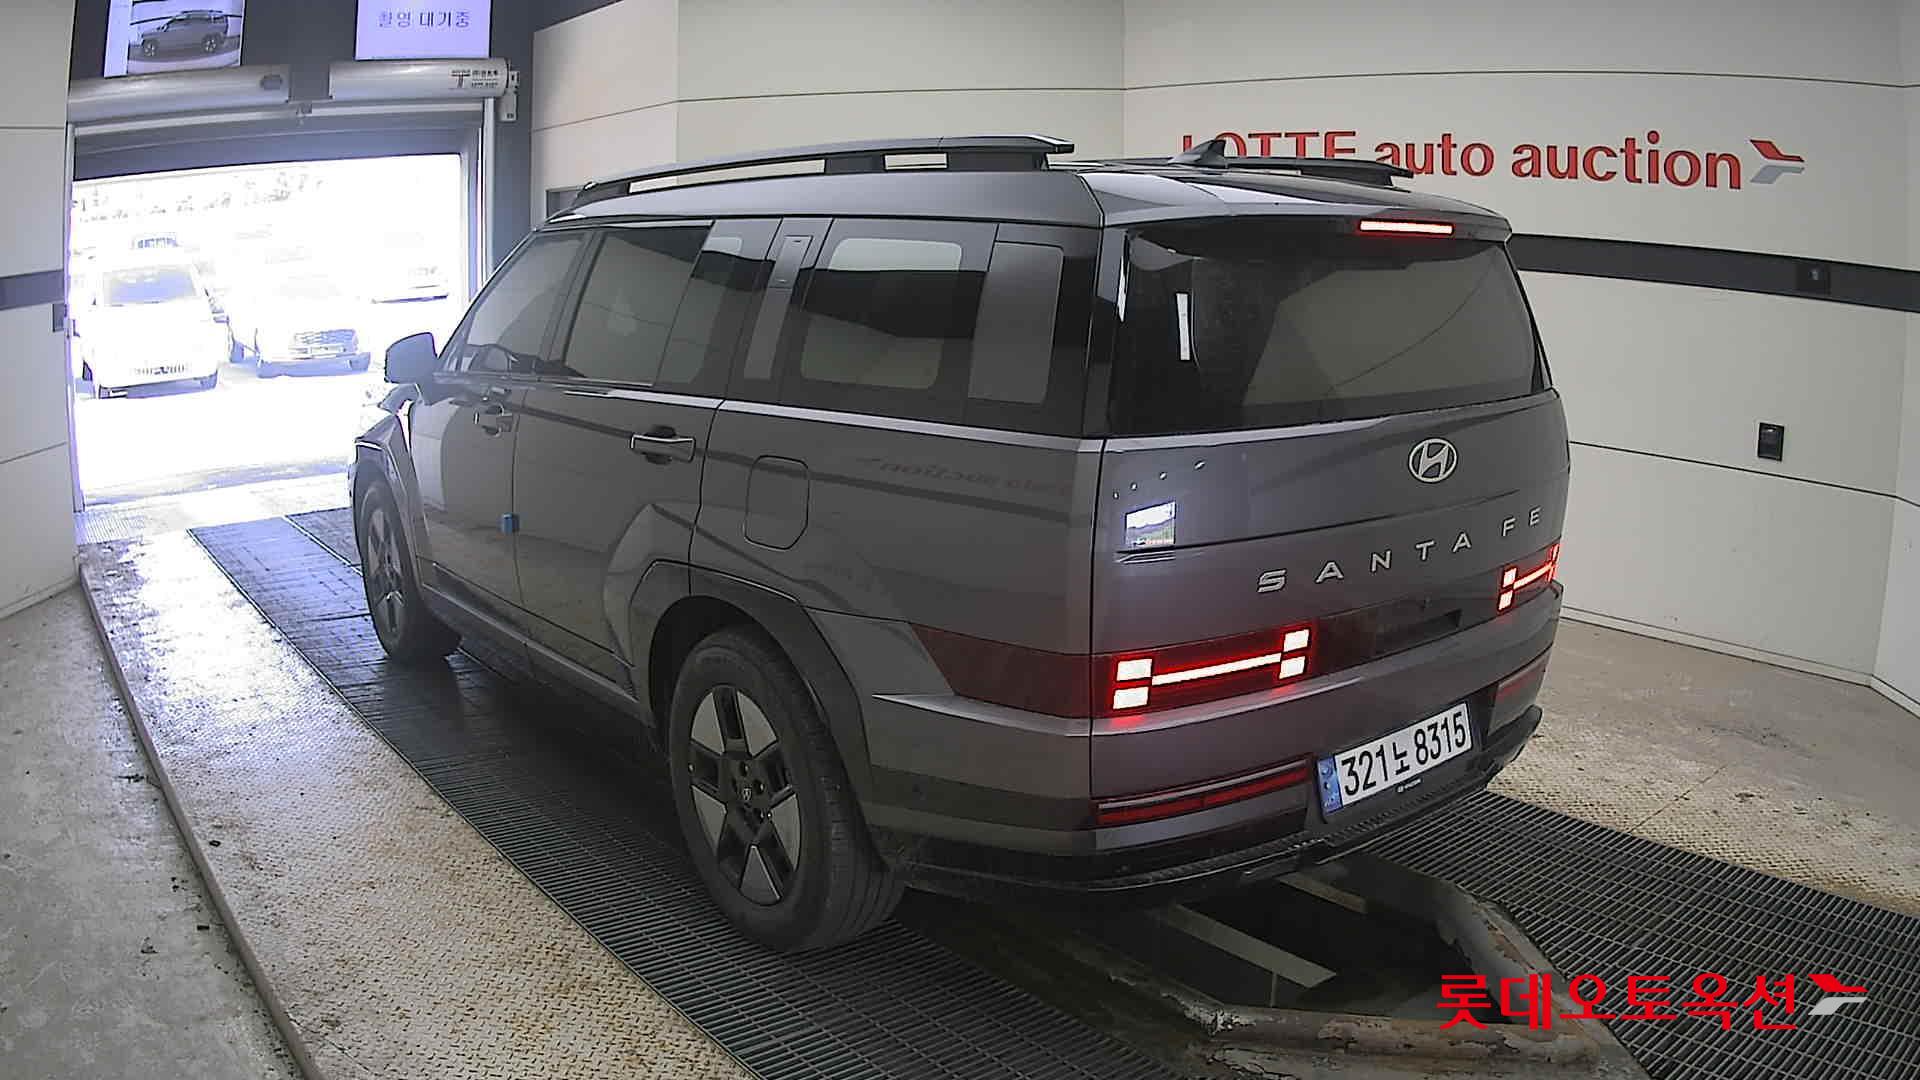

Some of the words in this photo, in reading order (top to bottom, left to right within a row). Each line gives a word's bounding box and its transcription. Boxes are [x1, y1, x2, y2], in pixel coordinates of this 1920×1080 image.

[419, 11, 472, 28] 대기중
[1183, 131, 1356, 159] TTE
[1375, 133, 1495, 176] auto
[1512, 131, 1741, 189] auction
[1257, 532, 1473, 593] SANTA
[1502, 507, 1542, 537] FE
[1341, 742, 1410, 796] 321노
[1414, 712, 1466, 765] 8315
